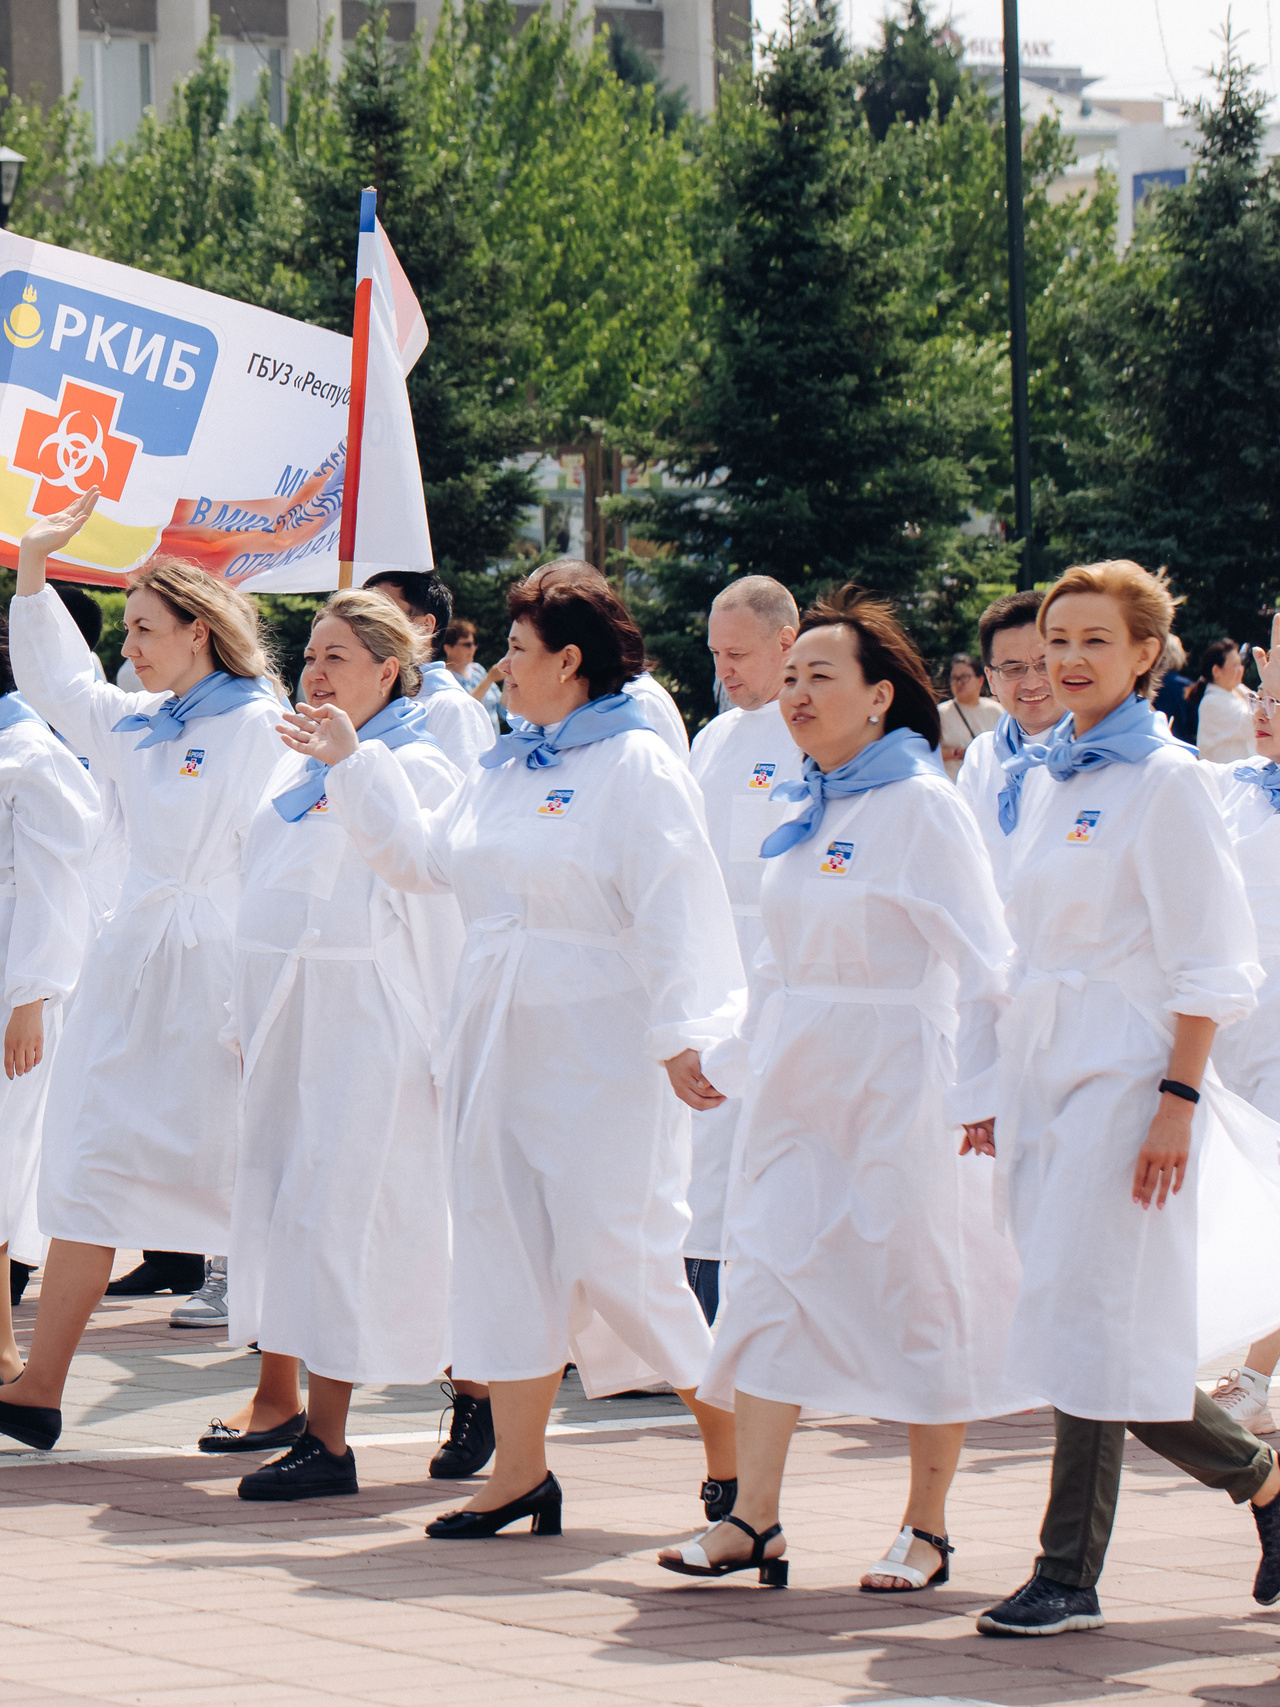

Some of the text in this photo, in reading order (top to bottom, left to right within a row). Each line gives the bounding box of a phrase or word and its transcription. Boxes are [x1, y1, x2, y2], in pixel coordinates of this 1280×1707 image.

[49, 303, 201, 391] РКИБ
[247, 352, 352, 408] ГБУЗ «Респуб
[188, 496, 213, 525] В
